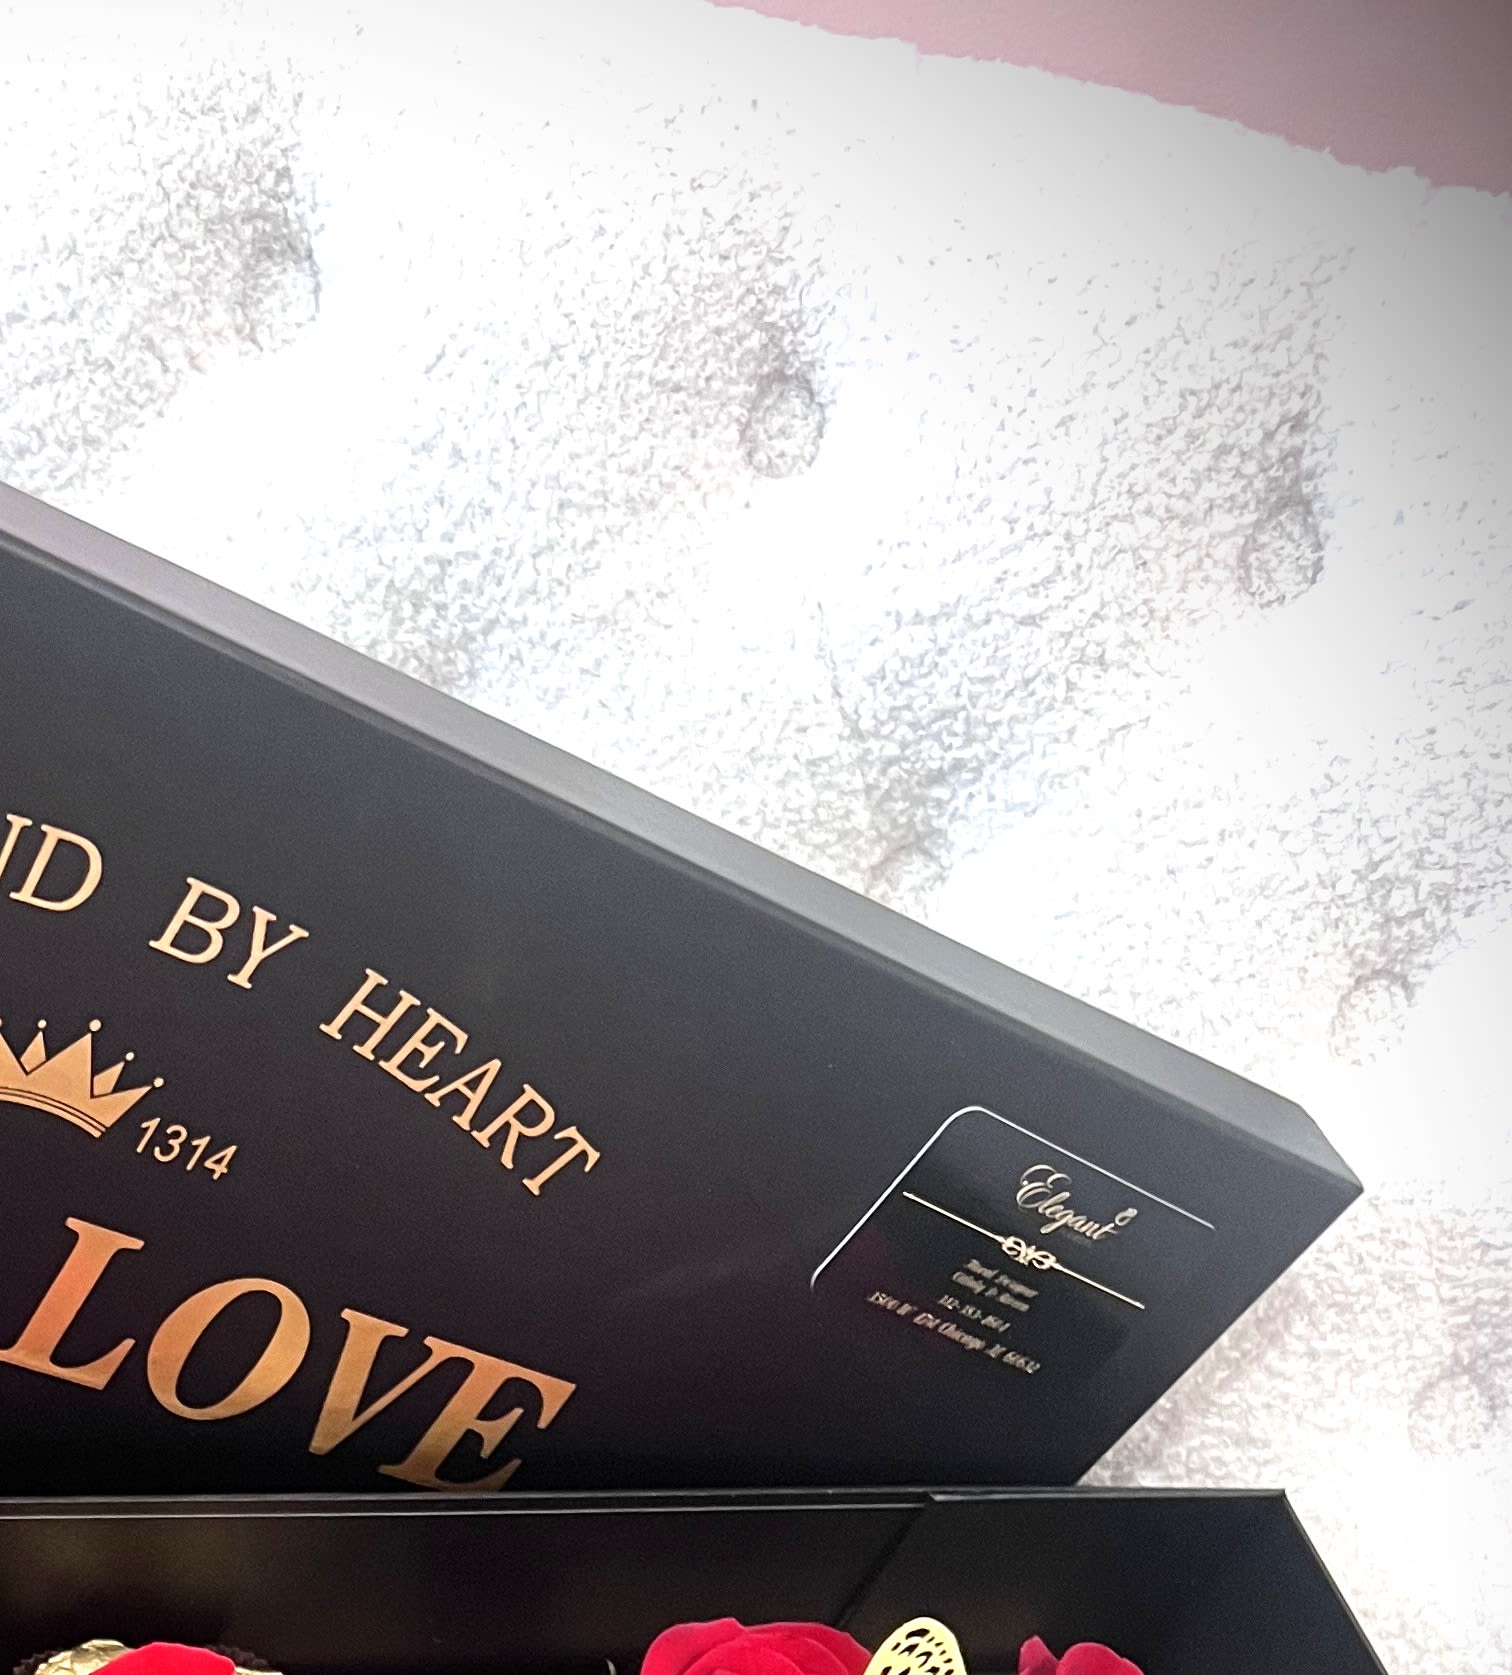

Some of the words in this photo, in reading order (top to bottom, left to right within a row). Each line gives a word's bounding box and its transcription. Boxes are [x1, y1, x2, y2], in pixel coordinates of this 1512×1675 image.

[149, 877, 309, 989] BY
[320, 968, 600, 1197] HEART
[136, 1117, 239, 1180] 1314
[1015, 1164, 1118, 1241] Elegant
